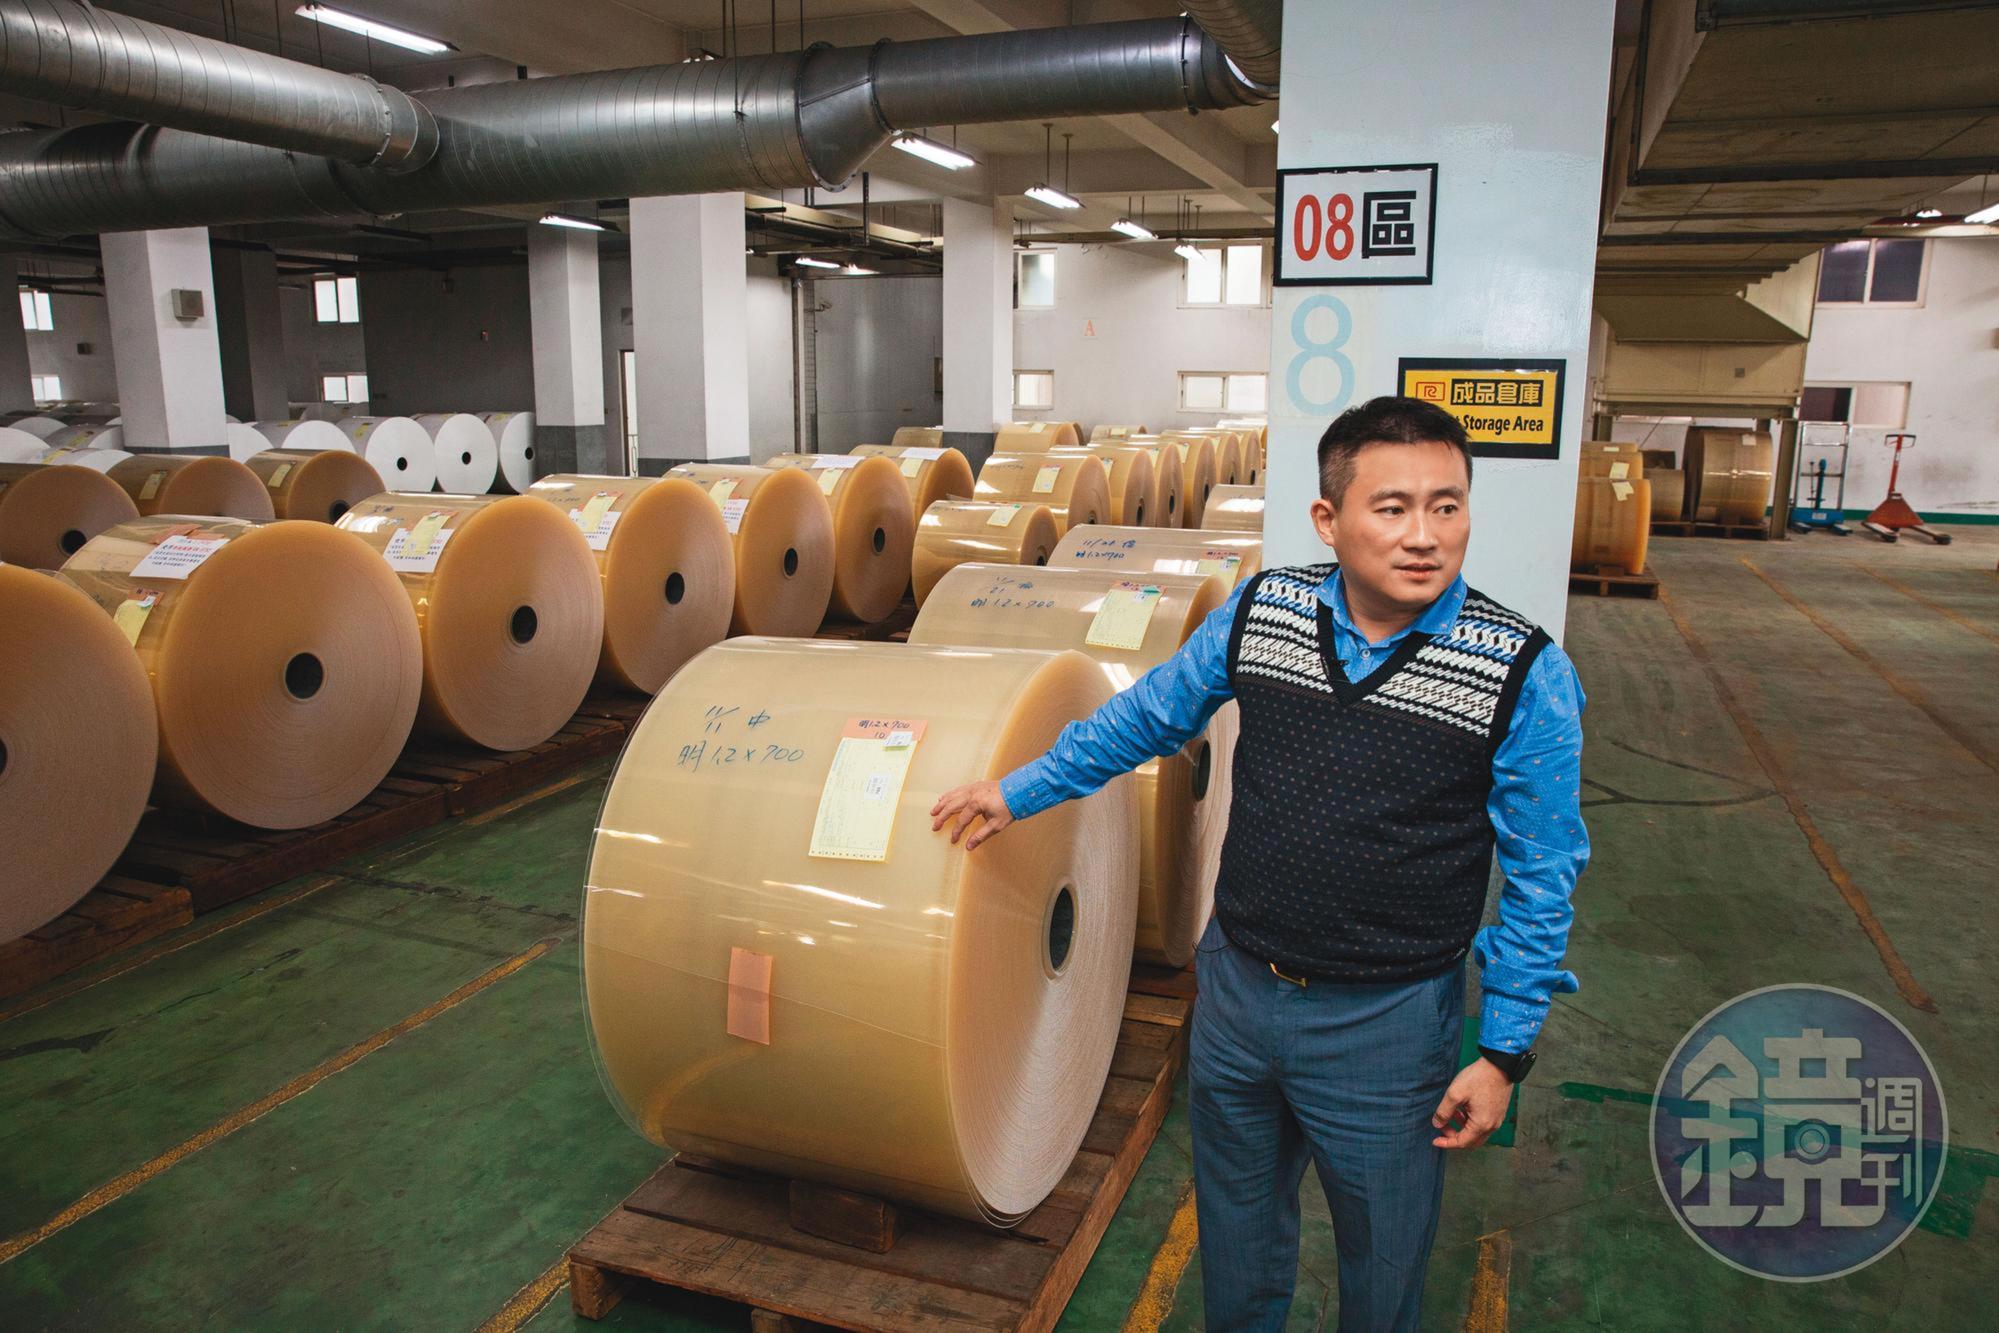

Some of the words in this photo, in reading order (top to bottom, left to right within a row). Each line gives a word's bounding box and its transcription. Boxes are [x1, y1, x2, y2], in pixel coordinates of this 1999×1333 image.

[1083, 319, 1096, 336] A
[1286, 294, 1355, 416] 8
[1452, 382, 1542, 405] 成品倉庫
[1463, 414, 1511, 435] Storage
[1513, 416, 1544, 432] Area
[760, 744, 805, 763] 700
